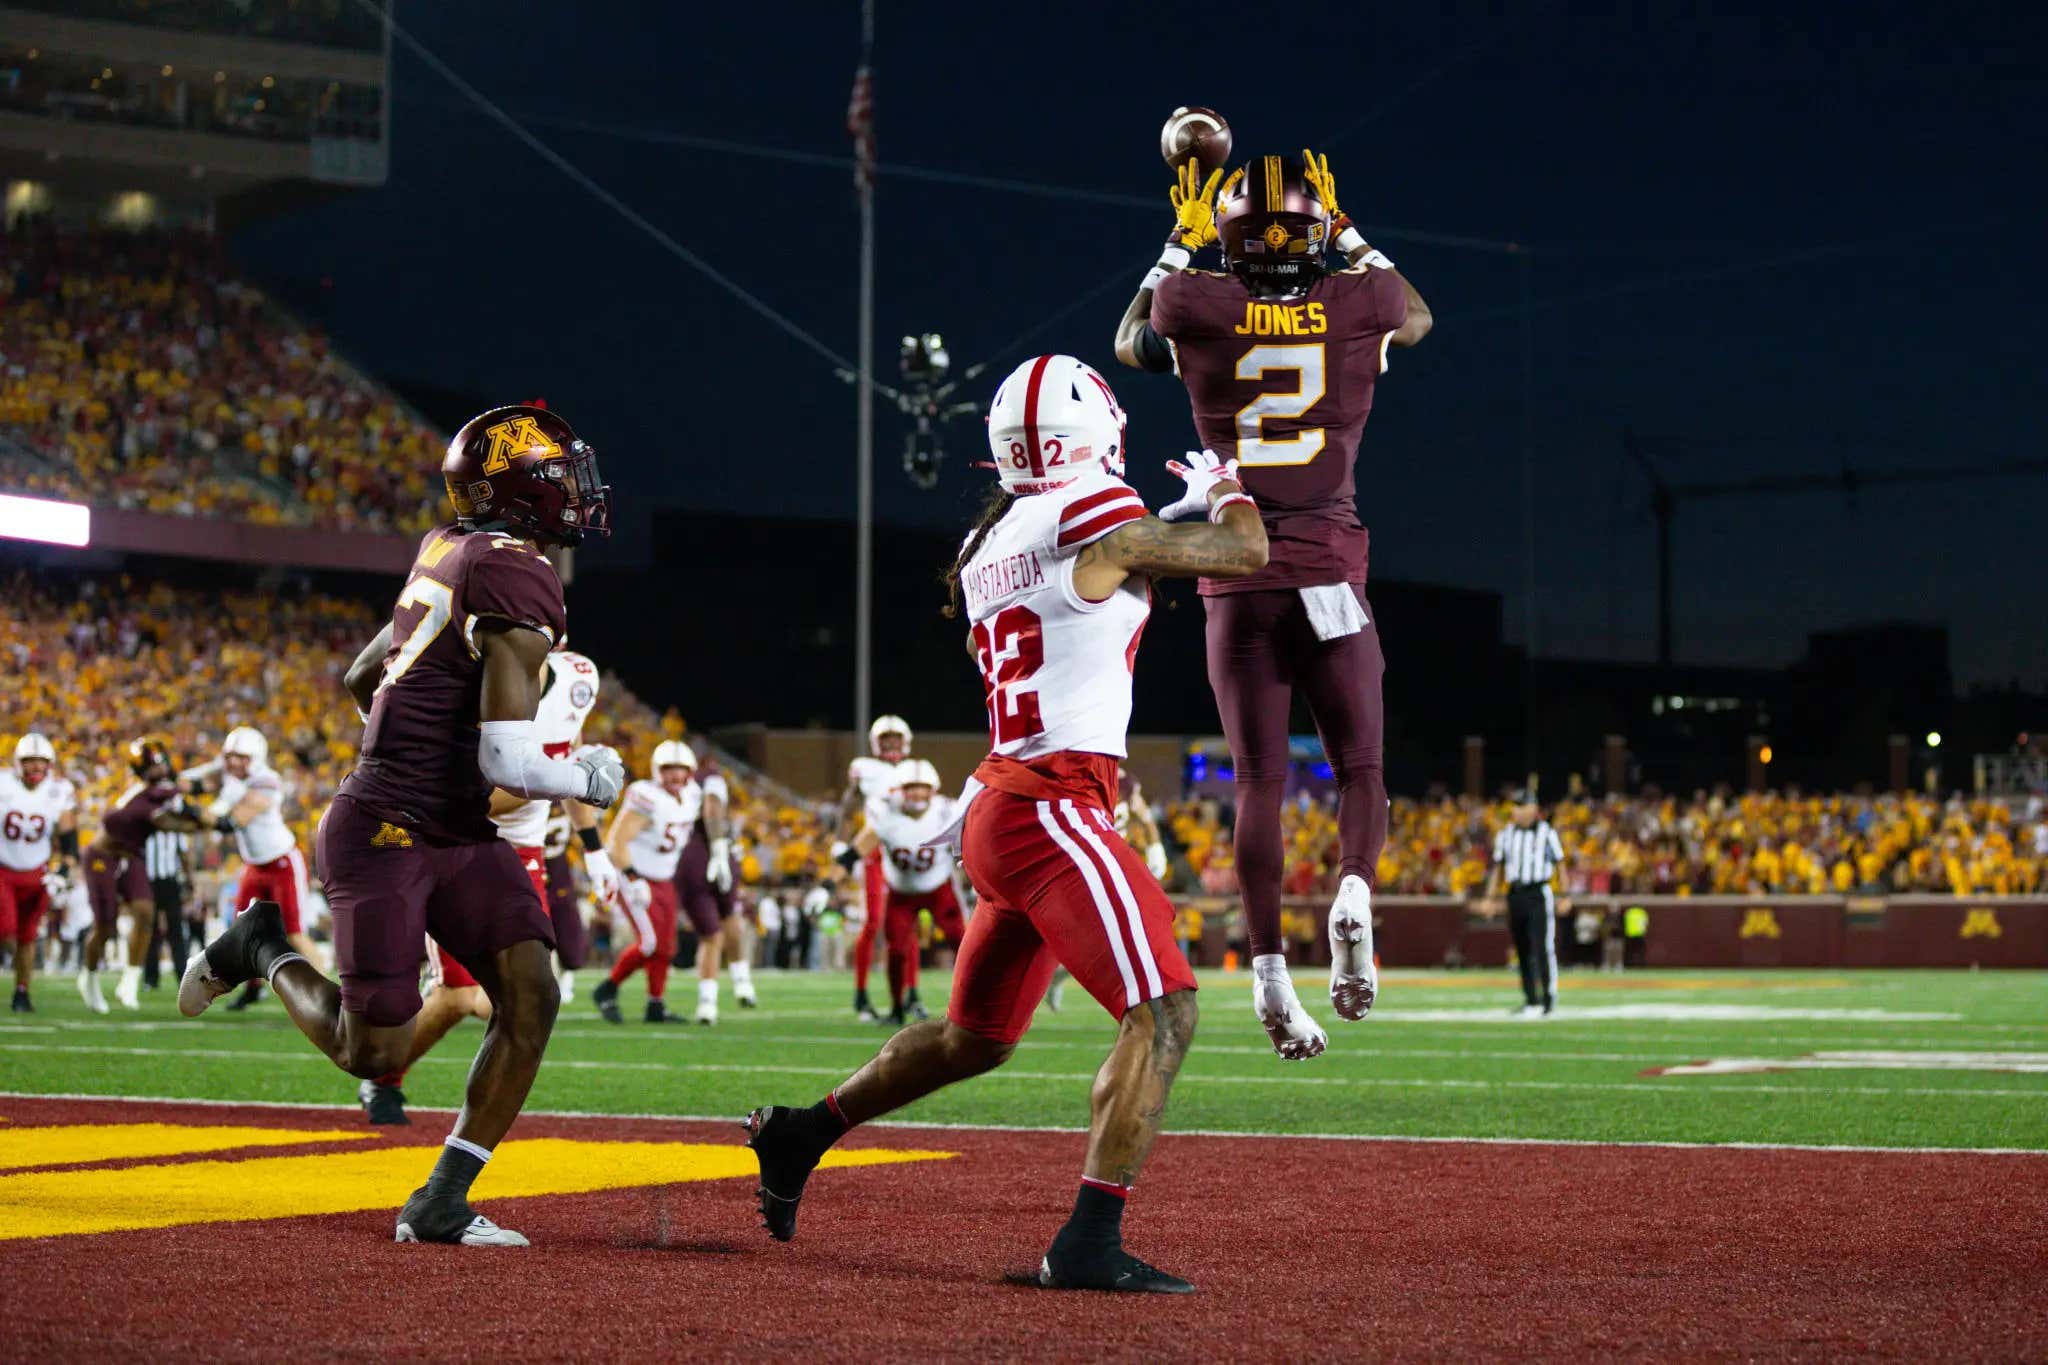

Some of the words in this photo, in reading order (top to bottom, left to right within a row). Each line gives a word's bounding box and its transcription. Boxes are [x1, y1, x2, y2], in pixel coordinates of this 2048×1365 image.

[1249, 264, 1299, 274] SKI-U-MAH
[1235, 302, 1328, 336] JONES
[1235, 342, 1327, 468] 2
[482, 416, 562, 477] M
[3, 811, 46, 843] 63
